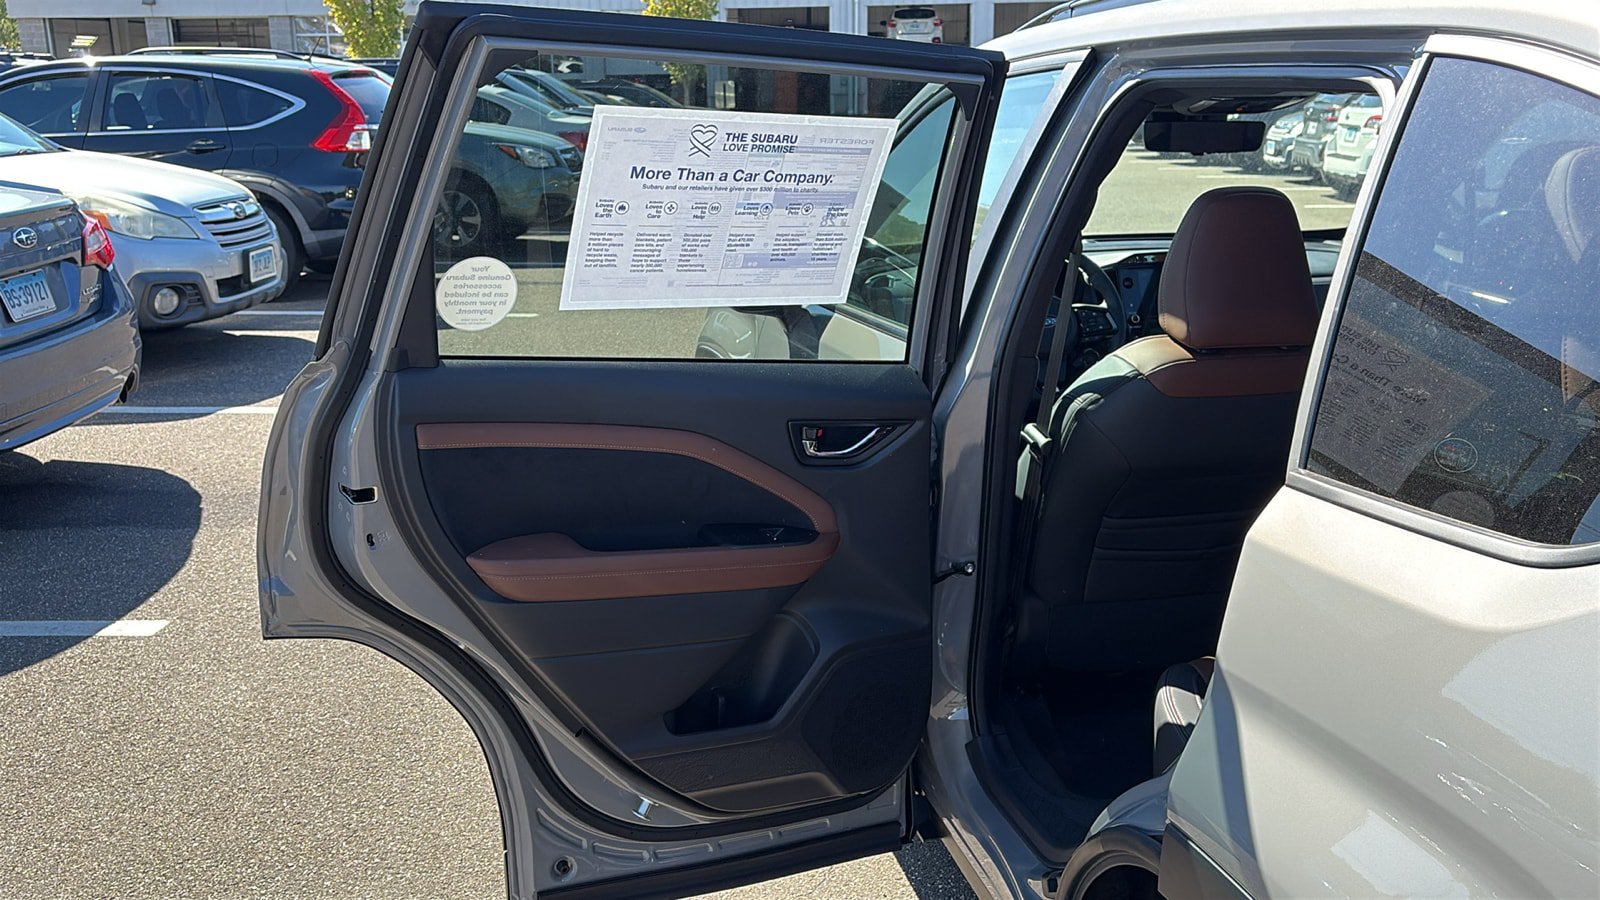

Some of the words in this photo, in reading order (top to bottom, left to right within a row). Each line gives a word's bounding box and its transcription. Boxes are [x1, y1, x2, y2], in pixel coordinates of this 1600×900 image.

[726, 133, 748, 142] THE
[751, 133, 798, 144] SUBARU
[723, 144, 748, 152] LOVE
[751, 144, 796, 153] PROMISE
[630, 166, 671, 180] More
[678, 168, 714, 180] Than
[719, 171, 728, 181] a
[733, 169, 760, 182] Car
[764, 170, 833, 186] Company.
